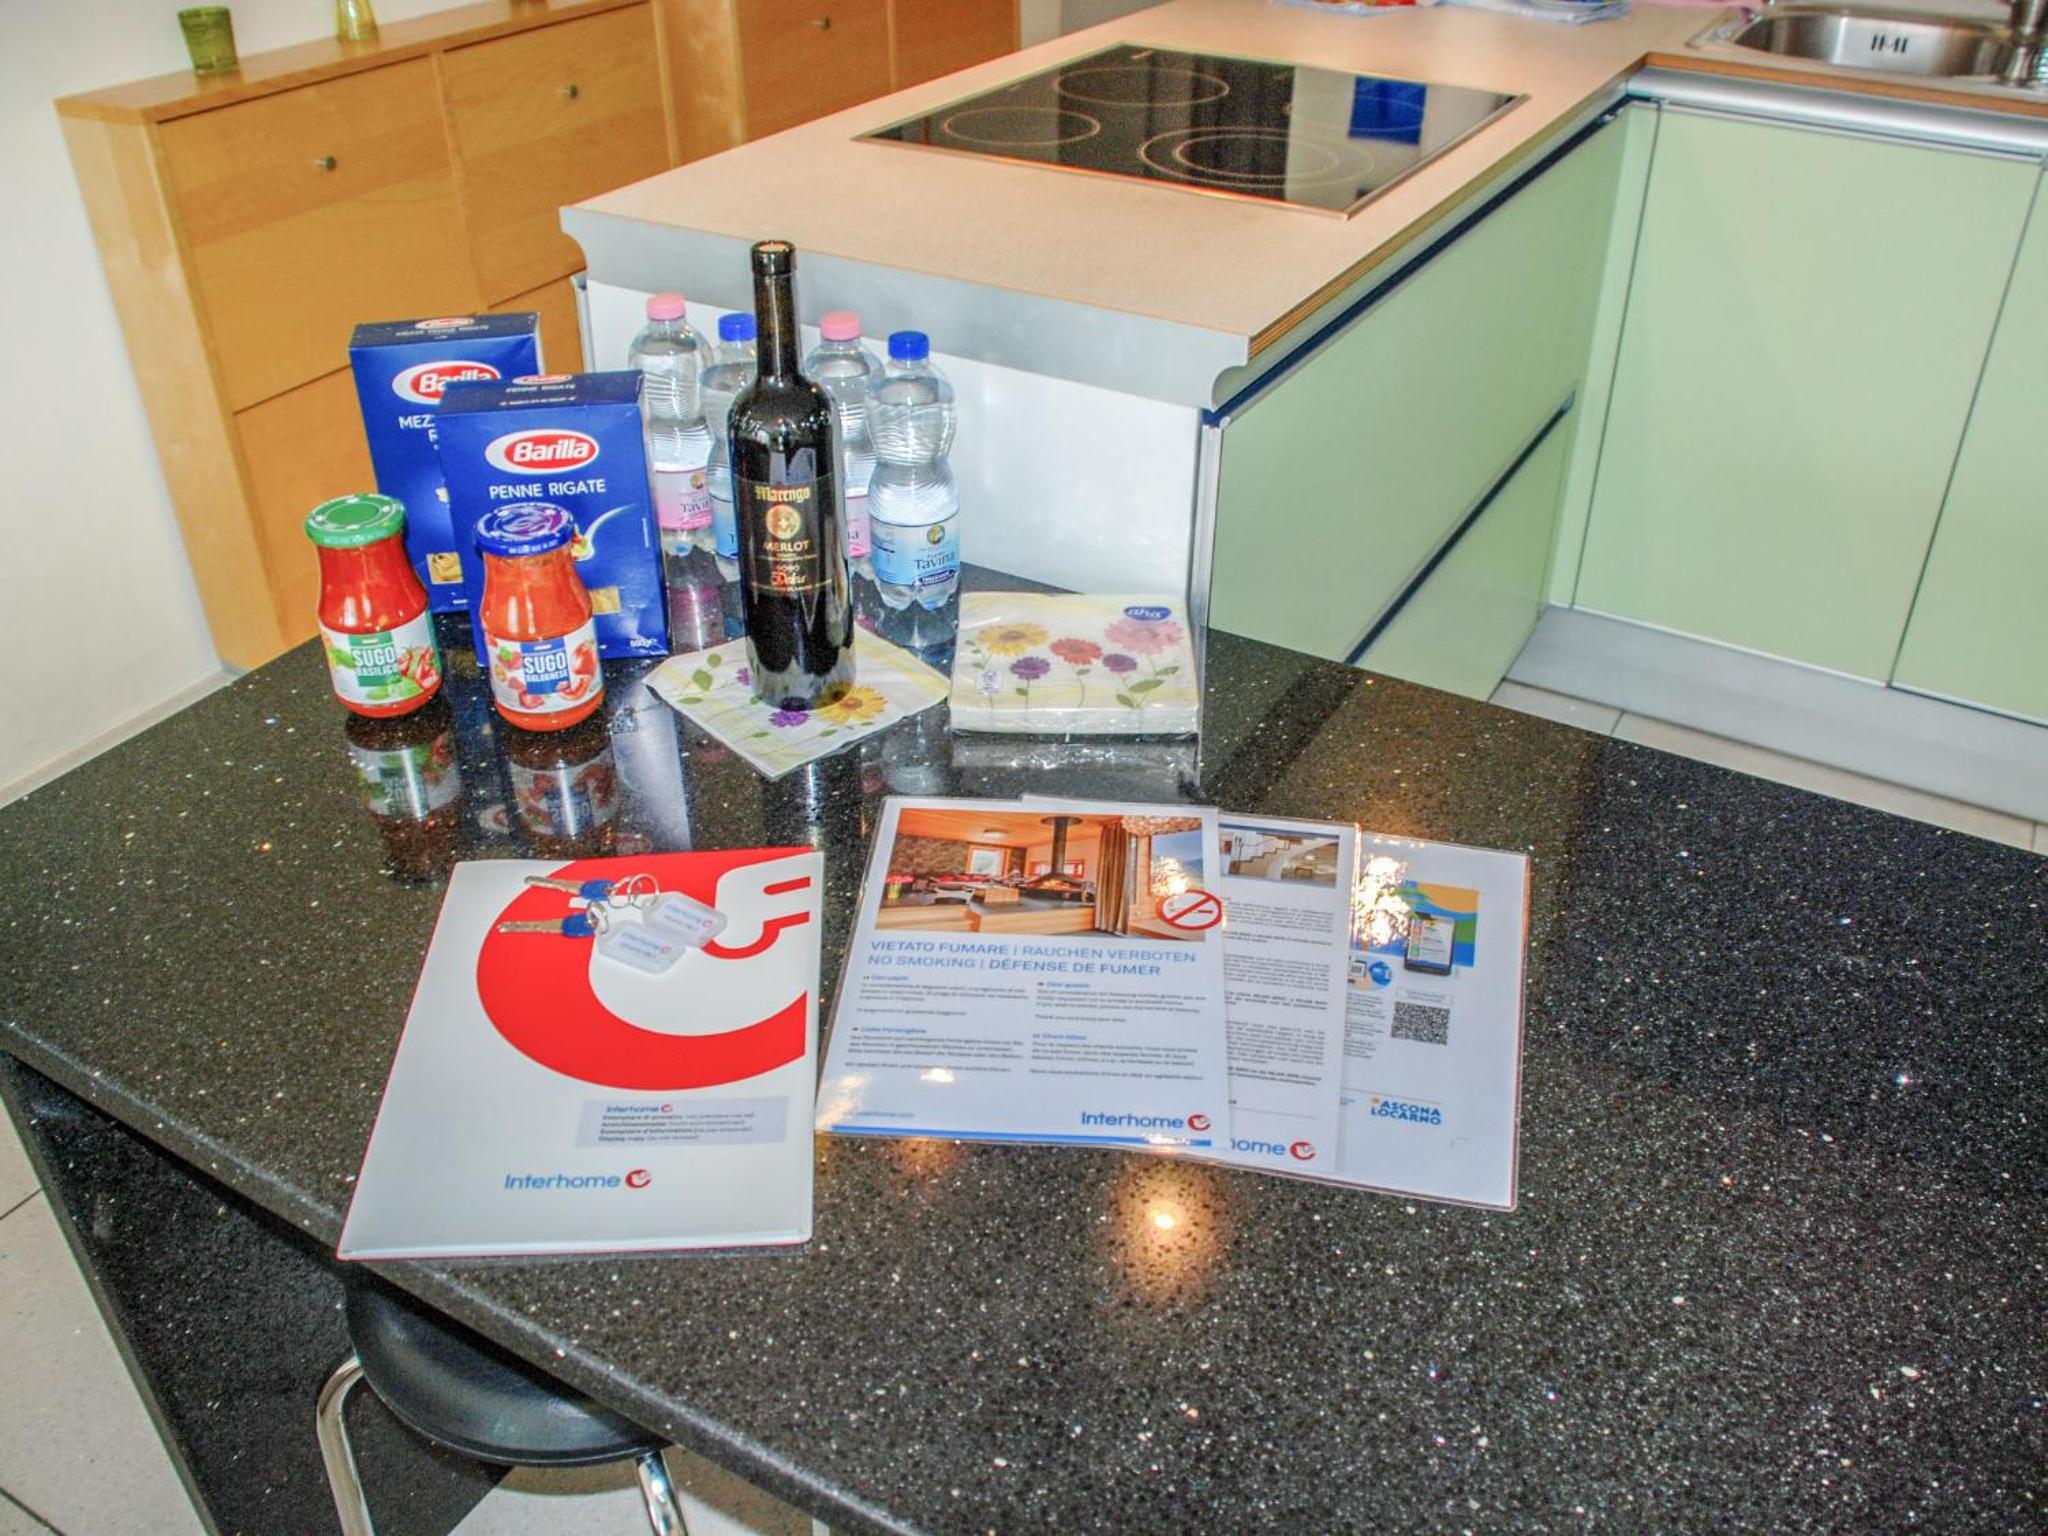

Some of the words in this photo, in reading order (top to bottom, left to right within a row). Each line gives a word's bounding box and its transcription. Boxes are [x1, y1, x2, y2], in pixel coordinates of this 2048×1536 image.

[398, 414, 436, 429] MEZ
[512, 438, 590, 463] Barilla
[489, 482, 543, 500] PENNE
[548, 478, 606, 496] RIGATE
[763, 540, 810, 552] MERLOT
[352, 646, 396, 667] SUGO
[524, 652, 566, 674] SUGO
[871, 940, 935, 952] VIETATO
[936, 942, 1008, 954] FUMARE
[1021, 945, 1102, 959] RAUCHEN
[1108, 949, 1196, 962] VERBOTEN
[868, 955, 892, 965] NO
[896, 956, 975, 968] SMOKING
[989, 957, 1067, 972] DÉFENSE
[1072, 962, 1094, 973] DE
[1100, 964, 1162, 976] FUMER
[1371, 1106, 1442, 1125] LOCARNO
[1380, 1100, 1441, 1117] ASCONA
[1081, 1111, 1184, 1129] Interhome
[504, 1173, 621, 1189] Interhome
